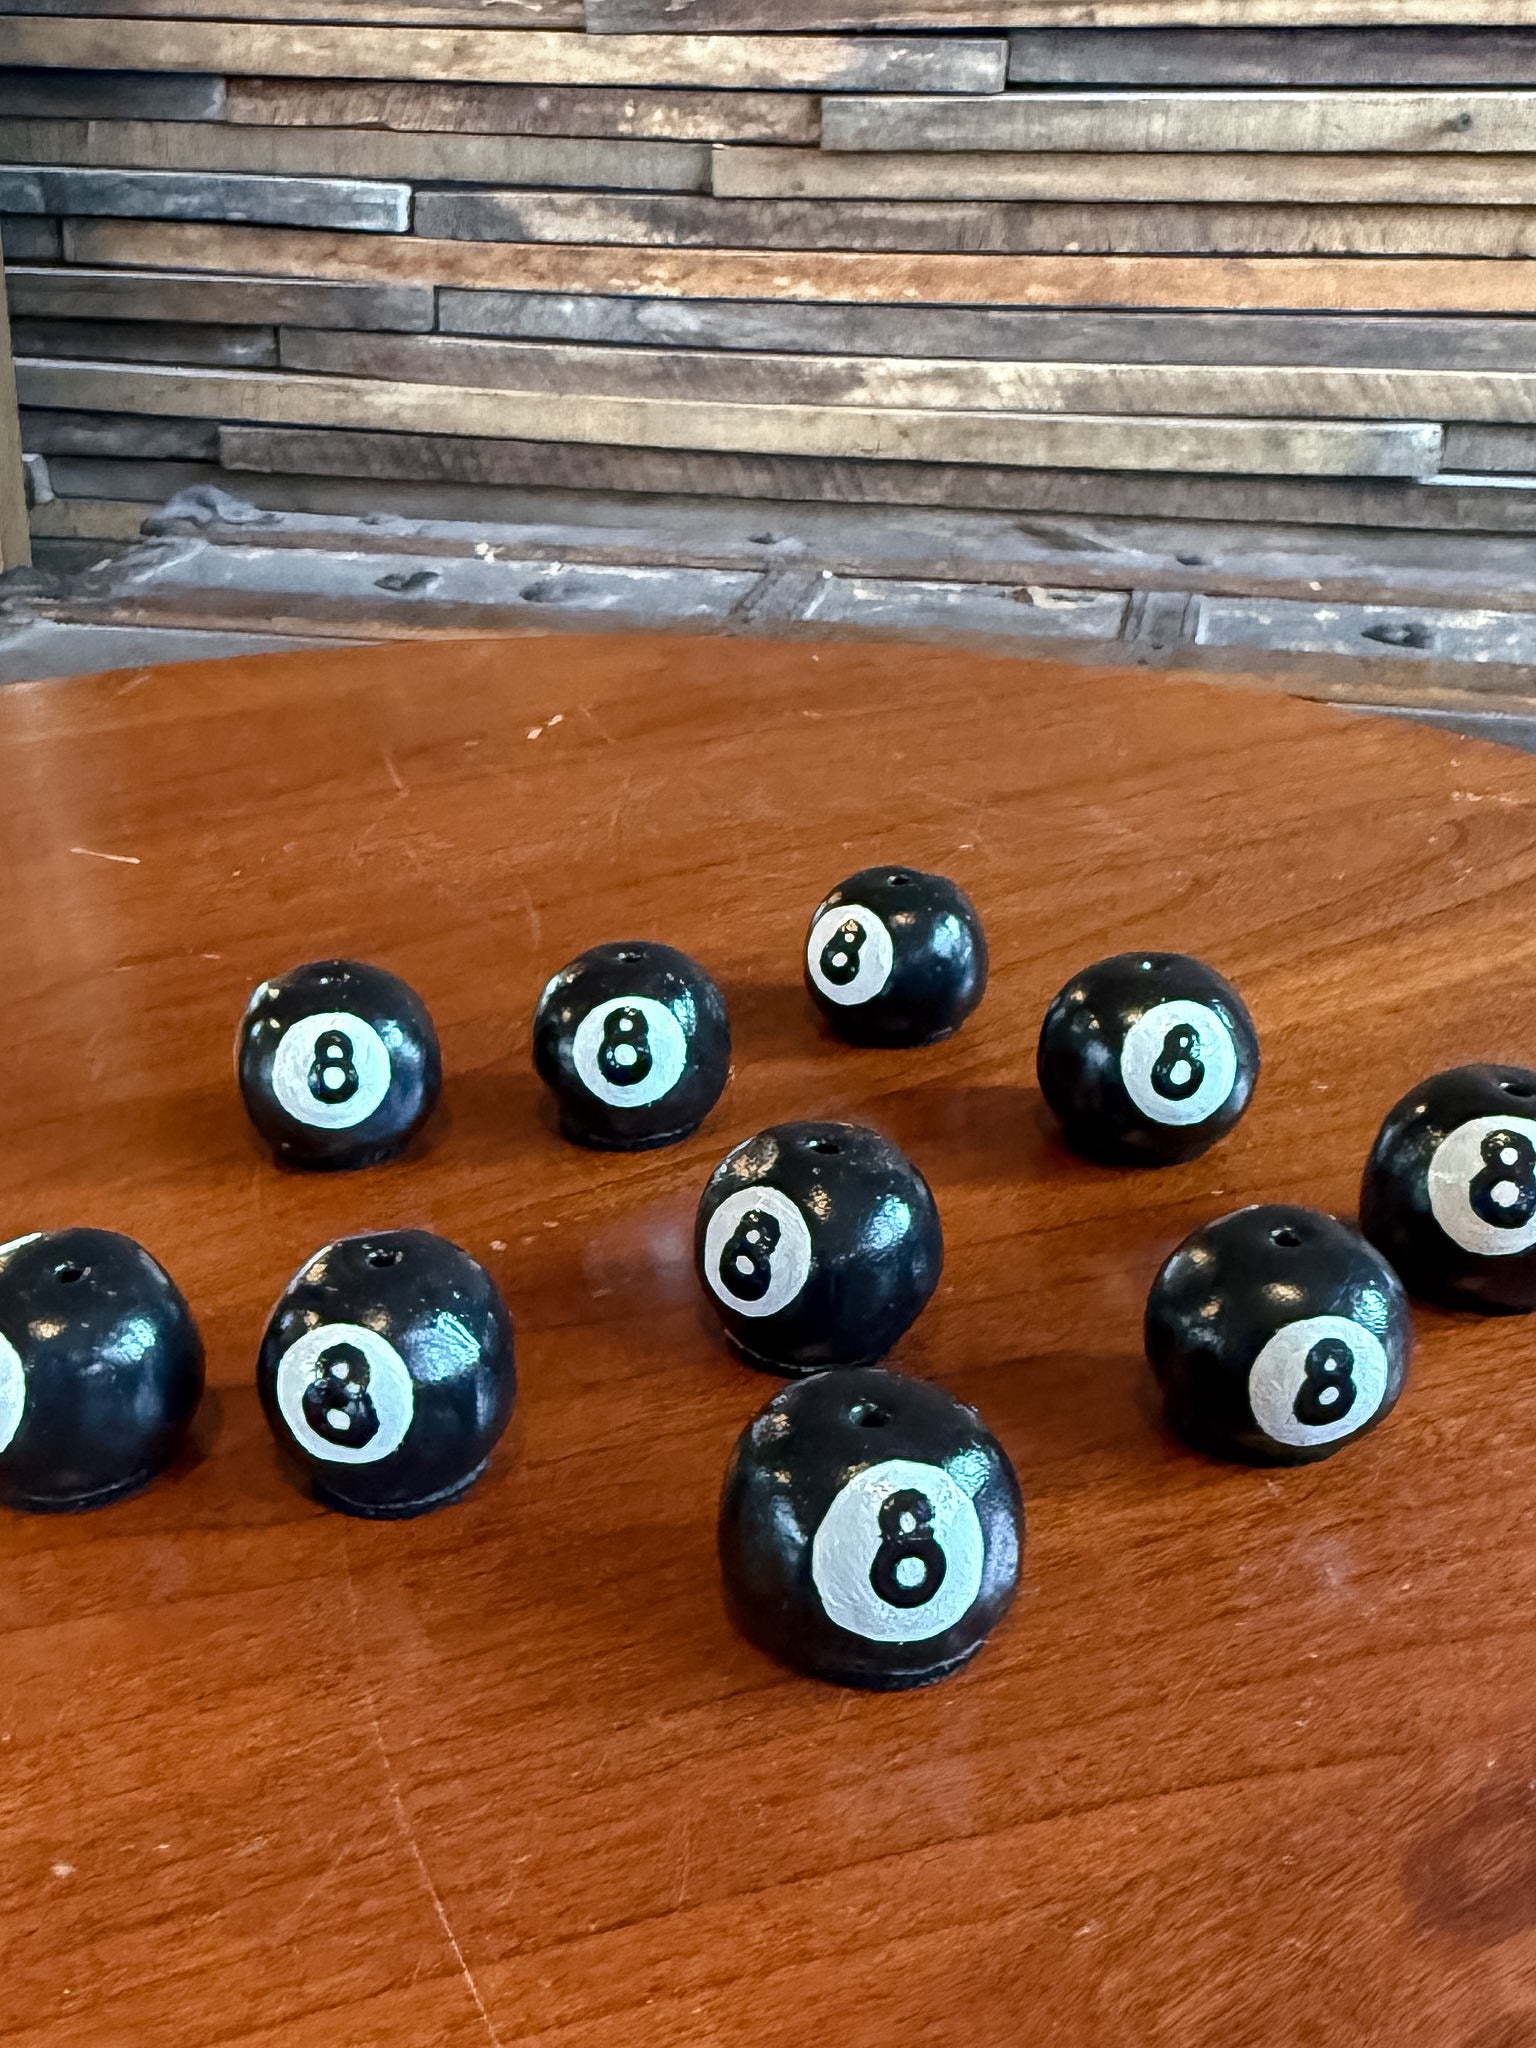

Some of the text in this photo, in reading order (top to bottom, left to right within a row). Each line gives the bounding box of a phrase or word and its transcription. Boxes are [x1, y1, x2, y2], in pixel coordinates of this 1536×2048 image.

[820, 919, 867, 985] 8
[308, 1029, 359, 1104] 8
[598, 1006, 652, 1086] 8
[1151, 1023, 1204, 1101] 8
[1469, 1129, 1536, 1229] 8
[719, 1209, 781, 1300] 8
[302, 1343, 381, 1448] 8
[1293, 1337, 1357, 1426] 8
[870, 1488, 946, 1608] 8
